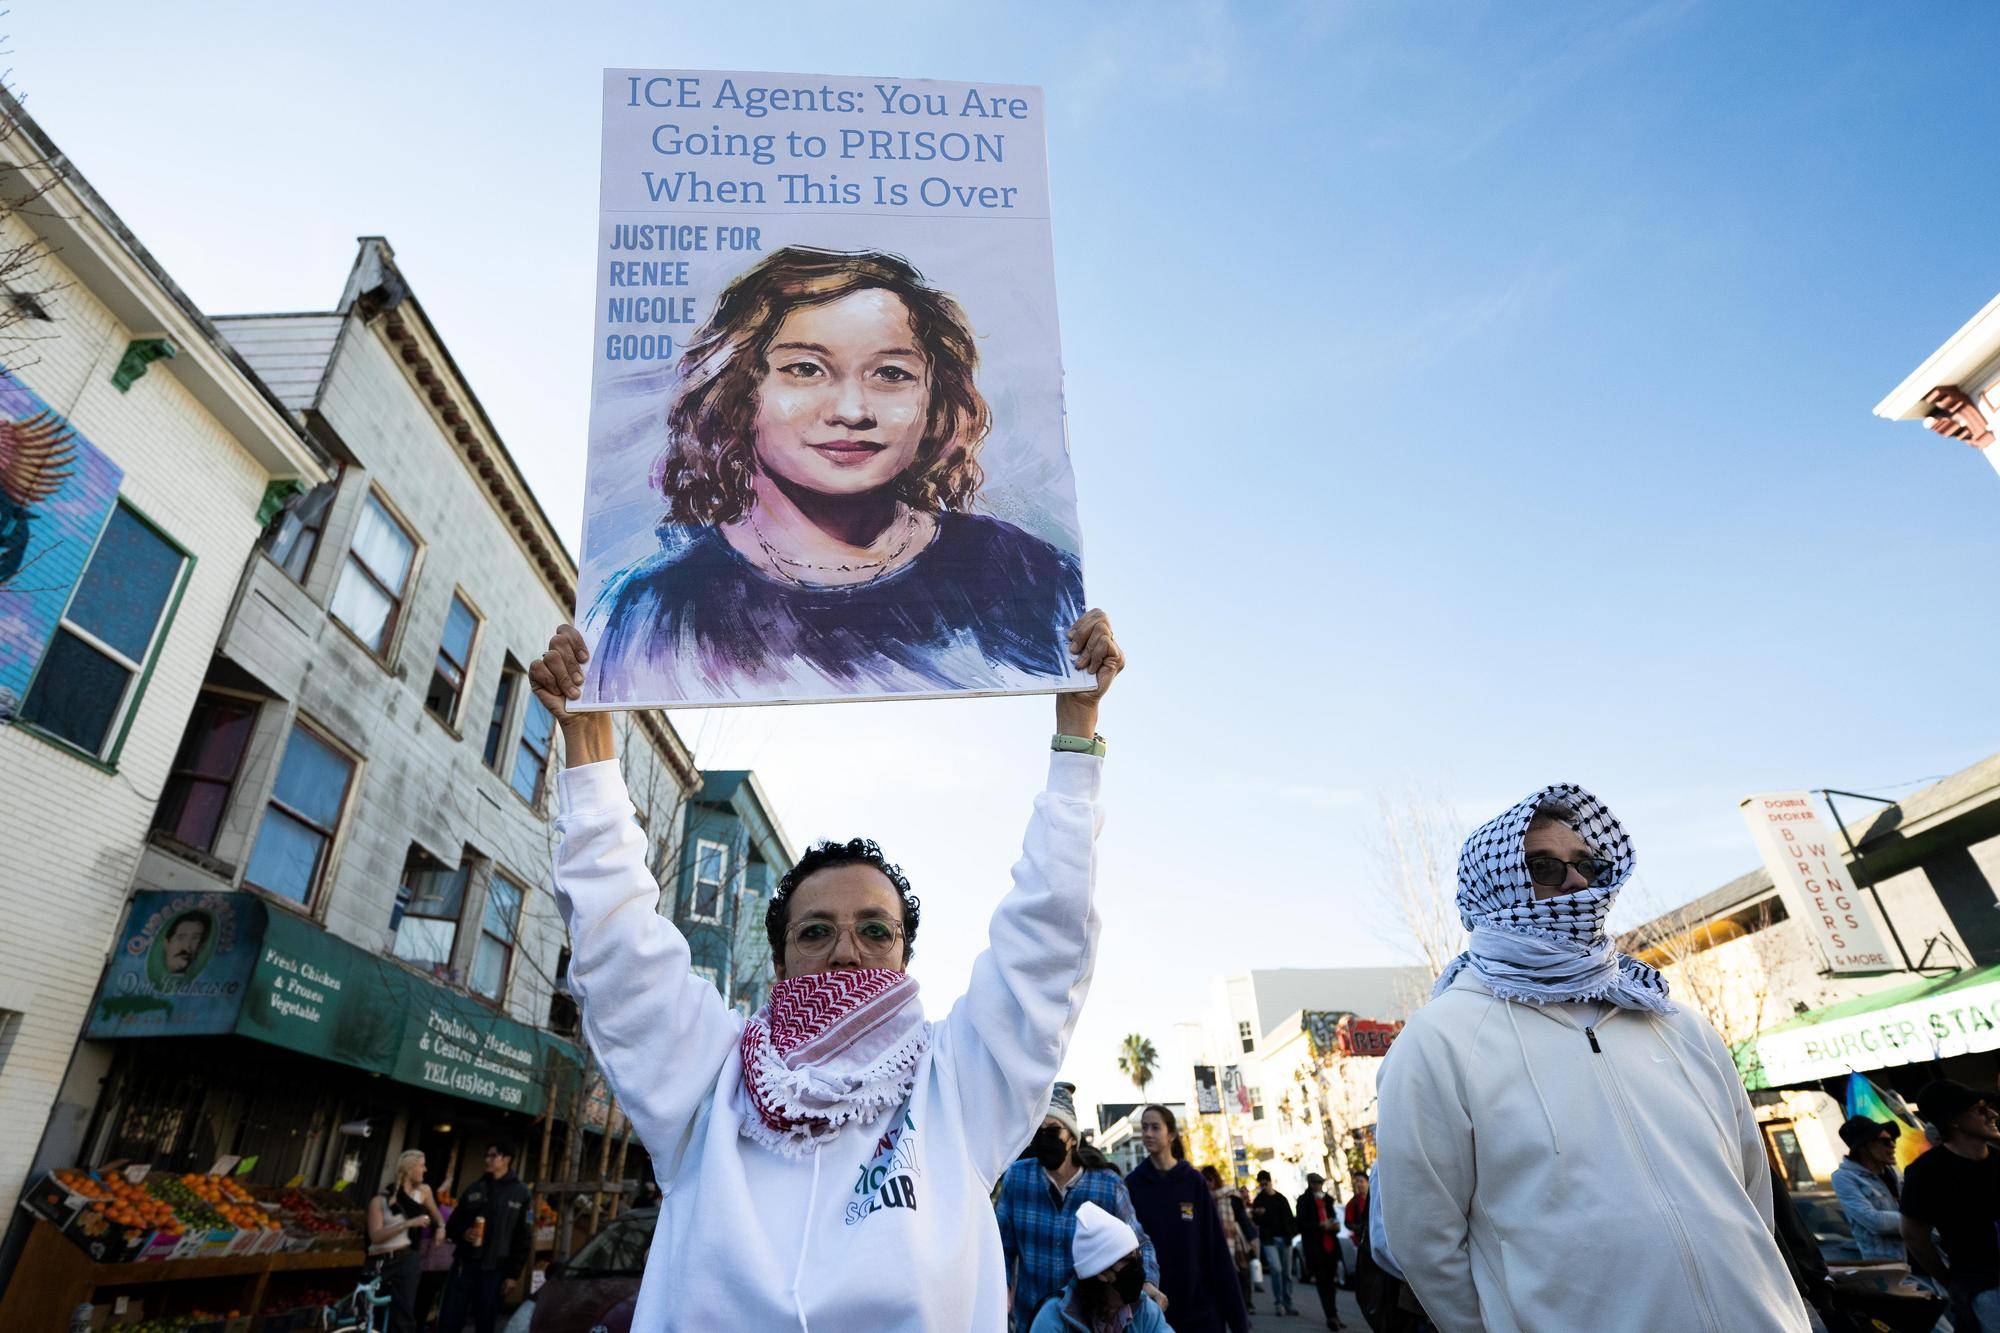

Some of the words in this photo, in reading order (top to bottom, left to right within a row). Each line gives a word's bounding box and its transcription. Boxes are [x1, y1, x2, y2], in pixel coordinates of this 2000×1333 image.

[628, 76, 700, 108] ICE
[713, 80, 864, 117] Agents:
[875, 85, 948, 116] You
[960, 89, 1028, 119] Are
[652, 124, 775, 165] Going
[786, 132, 827, 159] to
[840, 129, 1004, 162] PRISON
[642, 171, 766, 204] When
[778, 174, 861, 205] This
[874, 176, 908, 205] Is
[920, 178, 1017, 208] Over
[610, 224, 707, 251] JUSTICE
[717, 226, 761, 250] FOR
[610, 261, 689, 287] RENEE
[608, 297, 695, 324] NICOLE
[607, 334, 673, 360] GOOD
[1764, 799, 1807, 809] DOUBLE
[1768, 812, 1815, 822] DECKER
[1781, 828, 1845, 949] BURGERS
[1807, 844, 1858, 929] WINGS
[266, 949, 297, 974] Fresh
[301, 963, 341, 991] Chicken
[1846, 952, 1887, 966] MORE
[274, 976, 284, 989] &
[287, 978, 324, 1004] Frozen
[271, 993, 320, 1023] Vegetable
[1804, 1020, 1922, 1063] BURGER
